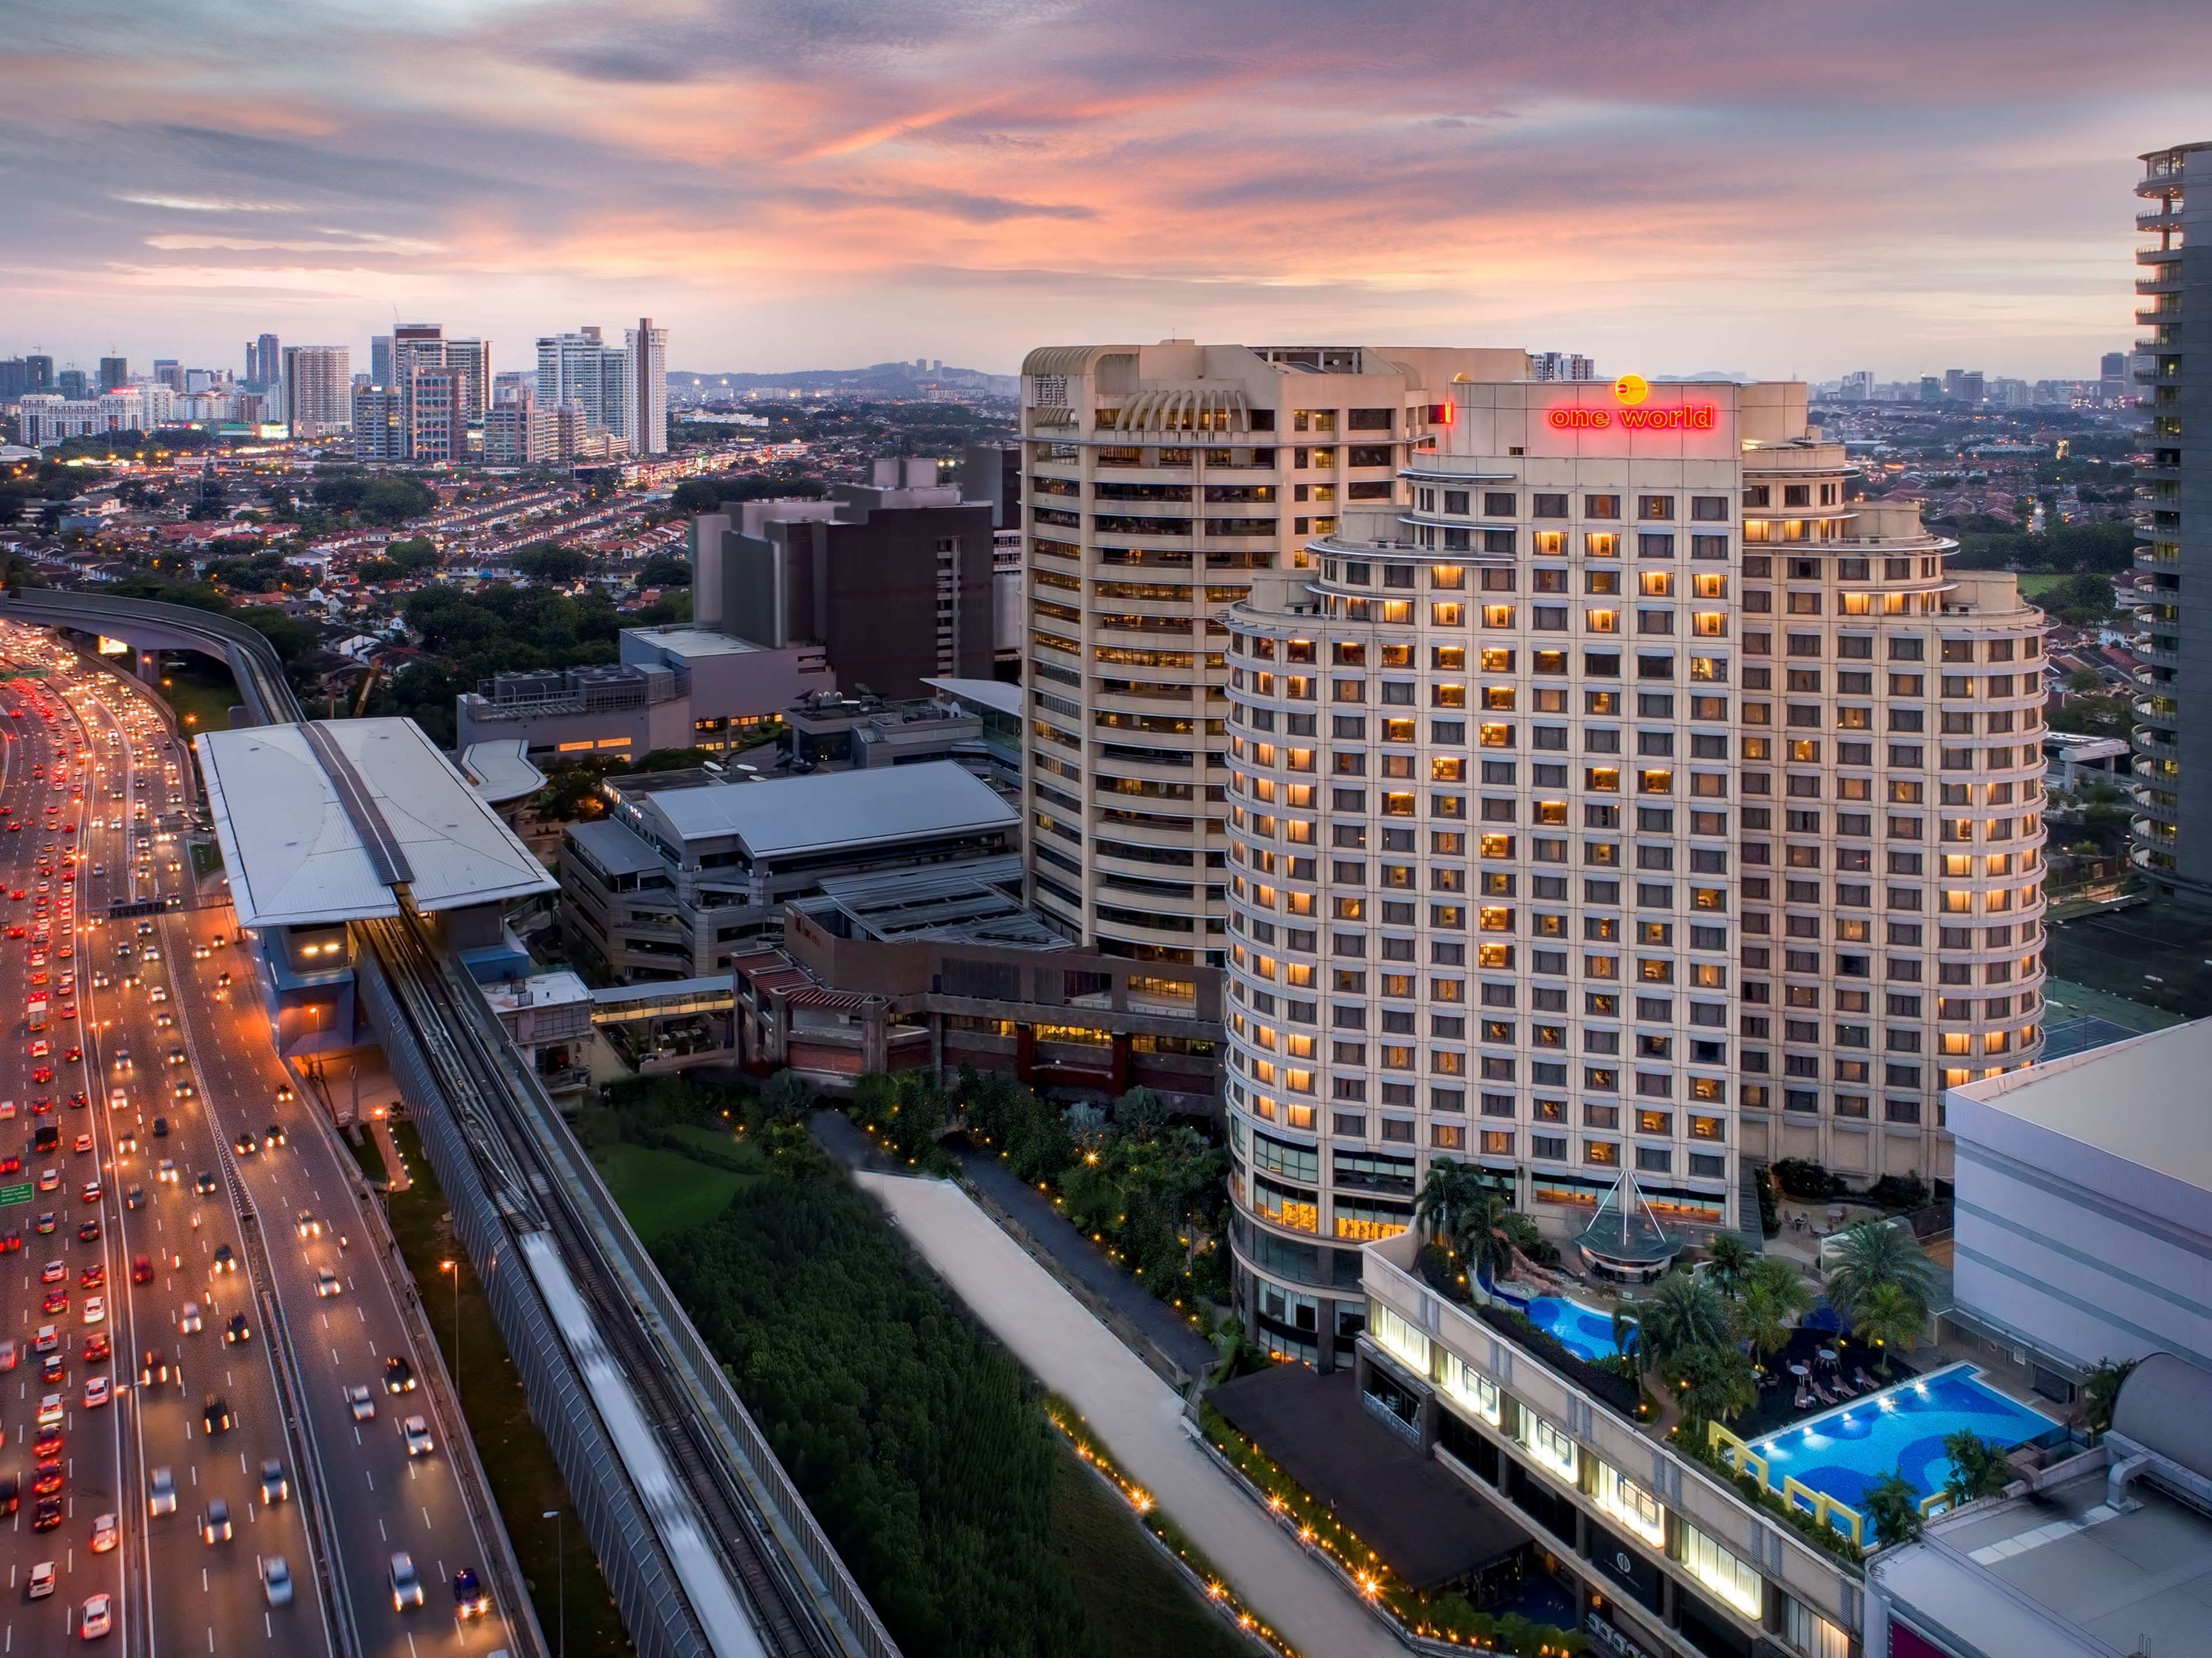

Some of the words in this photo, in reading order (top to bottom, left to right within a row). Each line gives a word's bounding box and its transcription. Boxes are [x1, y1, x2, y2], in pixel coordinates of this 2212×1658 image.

[1035, 376, 1067, 406] IBM
[1551, 410, 1610, 427] one
[1619, 405, 1713, 428] world
